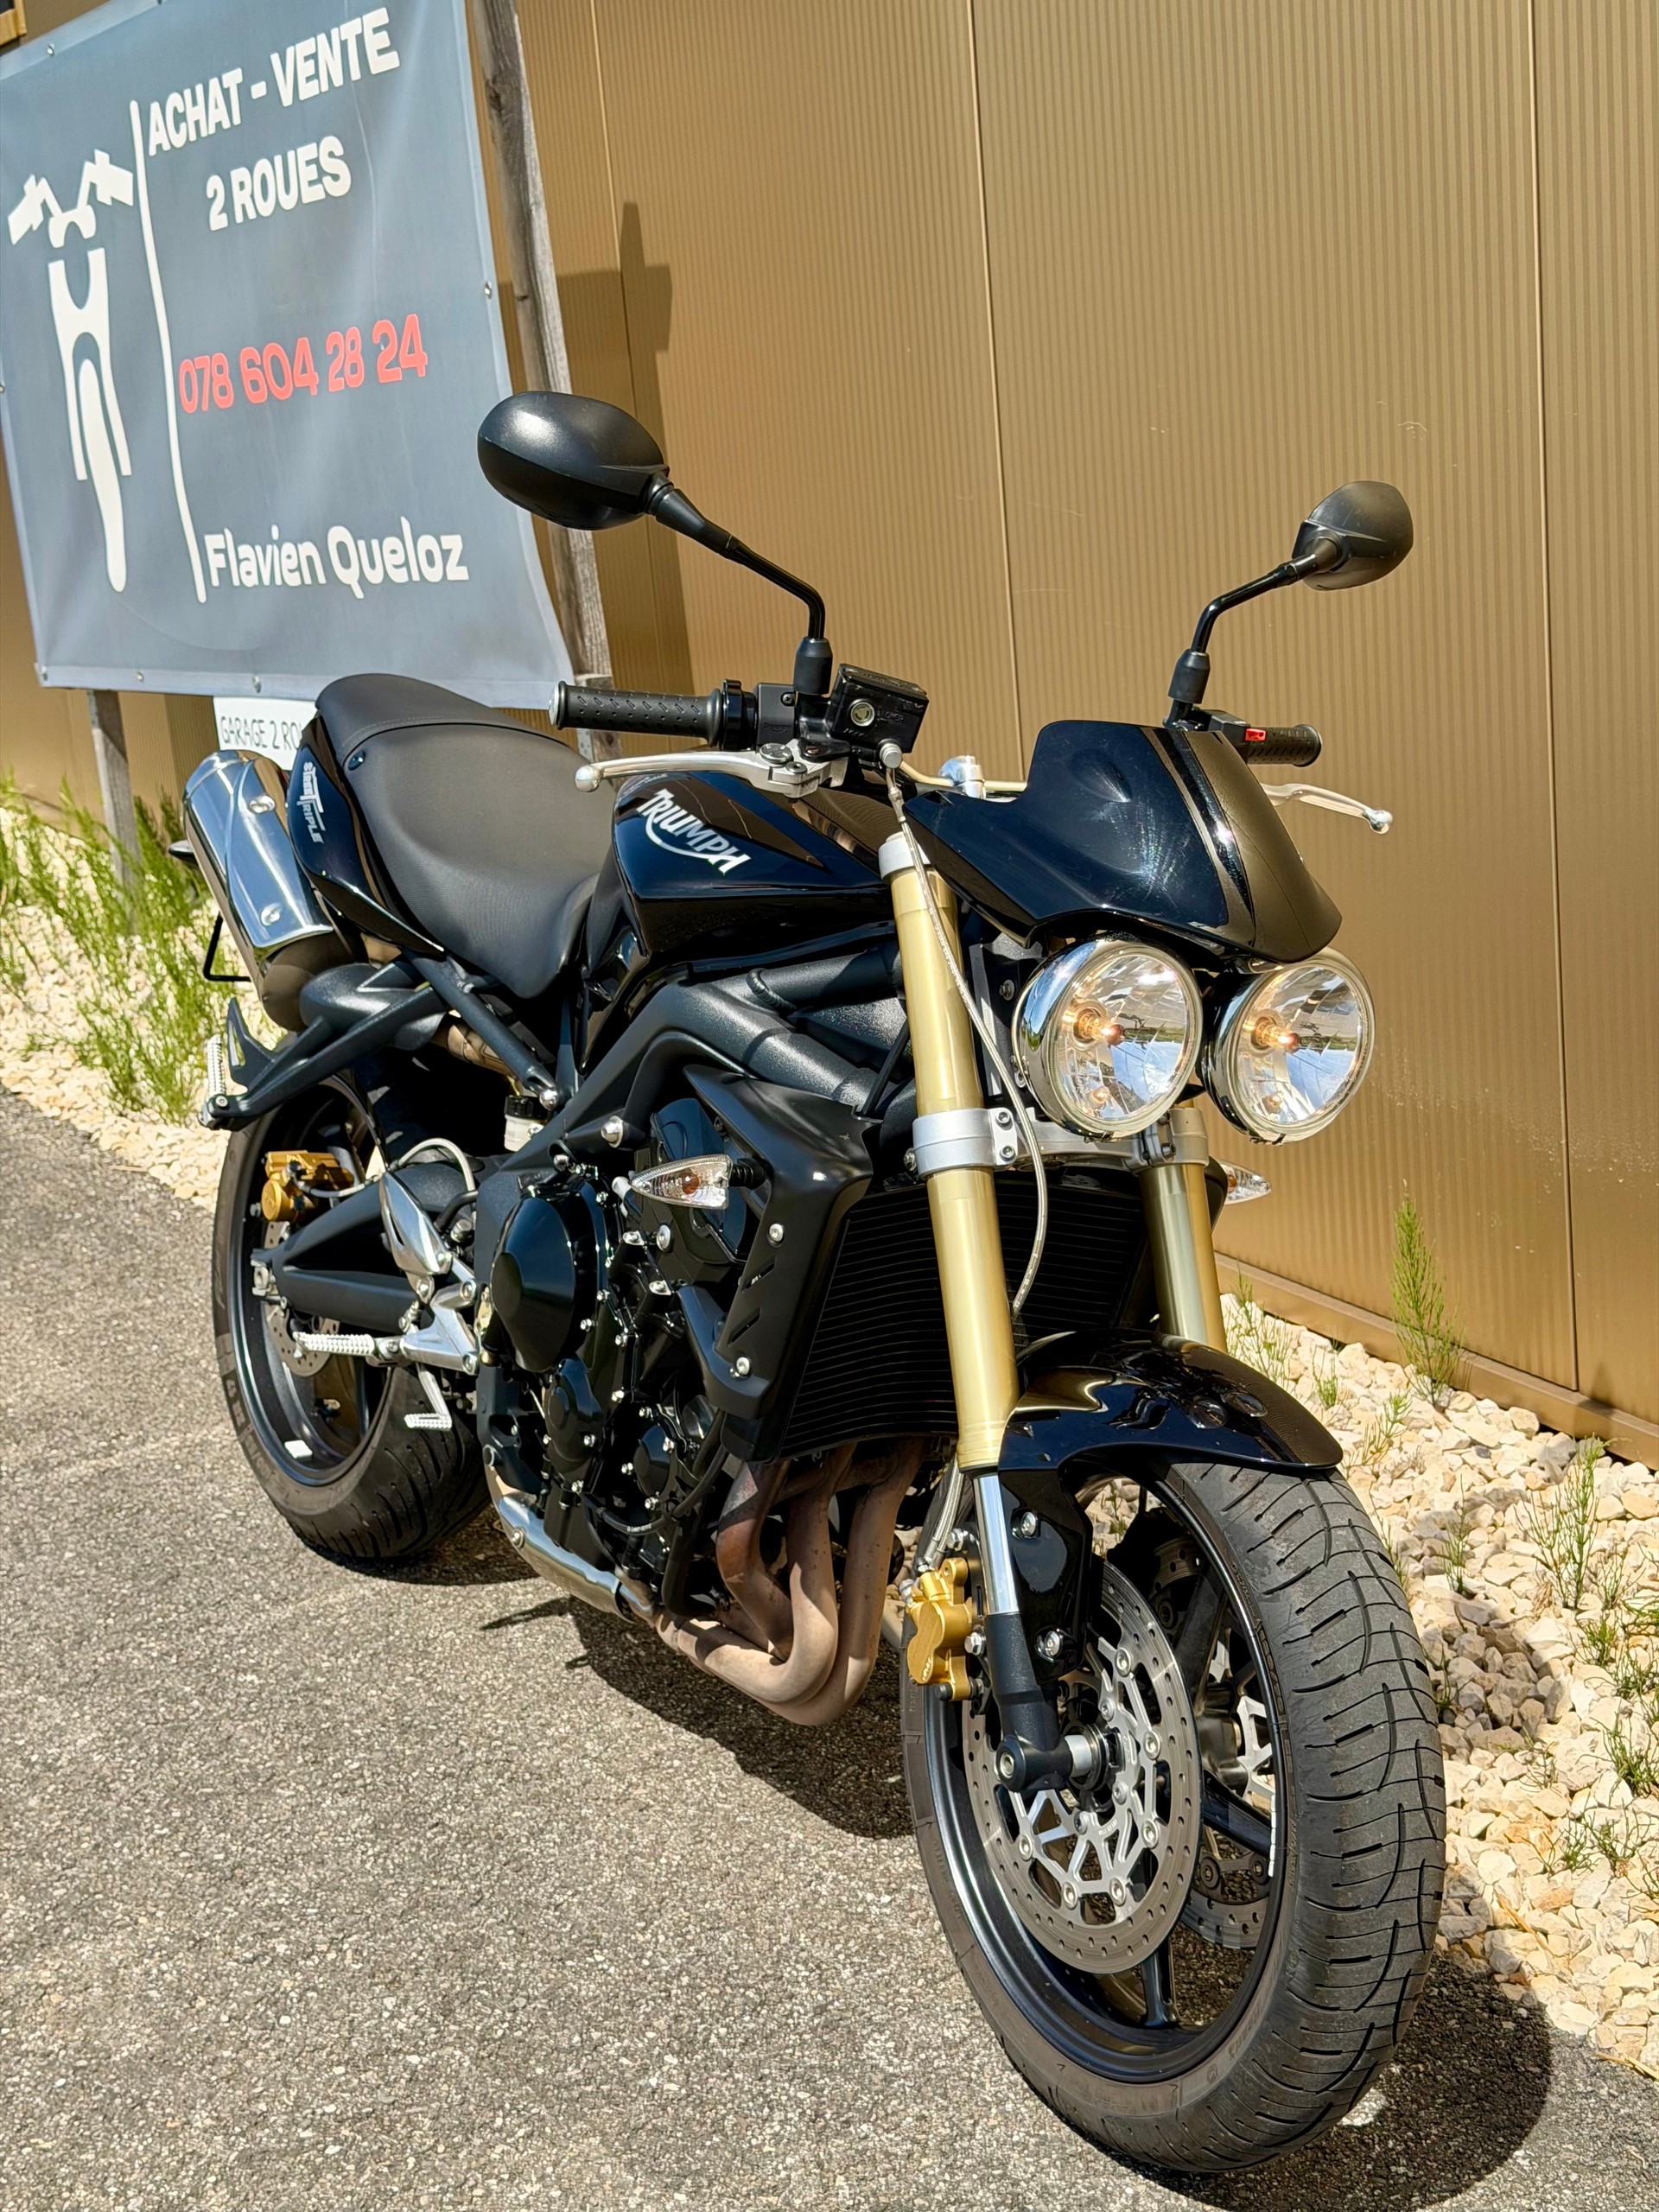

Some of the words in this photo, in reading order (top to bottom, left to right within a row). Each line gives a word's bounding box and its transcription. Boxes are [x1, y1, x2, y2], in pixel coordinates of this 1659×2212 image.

[149, 67, 243, 156] ACHAT
[251, 80, 267, 99] -
[270, 7, 400, 107] VENTE
[206, 175, 228, 231] 2
[230, 136, 352, 224] ROUES
[179, 353, 234, 414] 078
[239, 337, 319, 404] 604
[326, 327, 365, 392] 28
[372, 314, 428, 383] 24
[204, 524, 327, 588] Flavien
[327, 516, 469, 599] Queloz
[221, 716, 268, 747] GARAGE
[270, 720, 280, 749] 2
[281, 721, 302, 751] RO
[296, 798, 326, 843] TRIPLE
[636, 788, 752, 875] TRIUMPH
